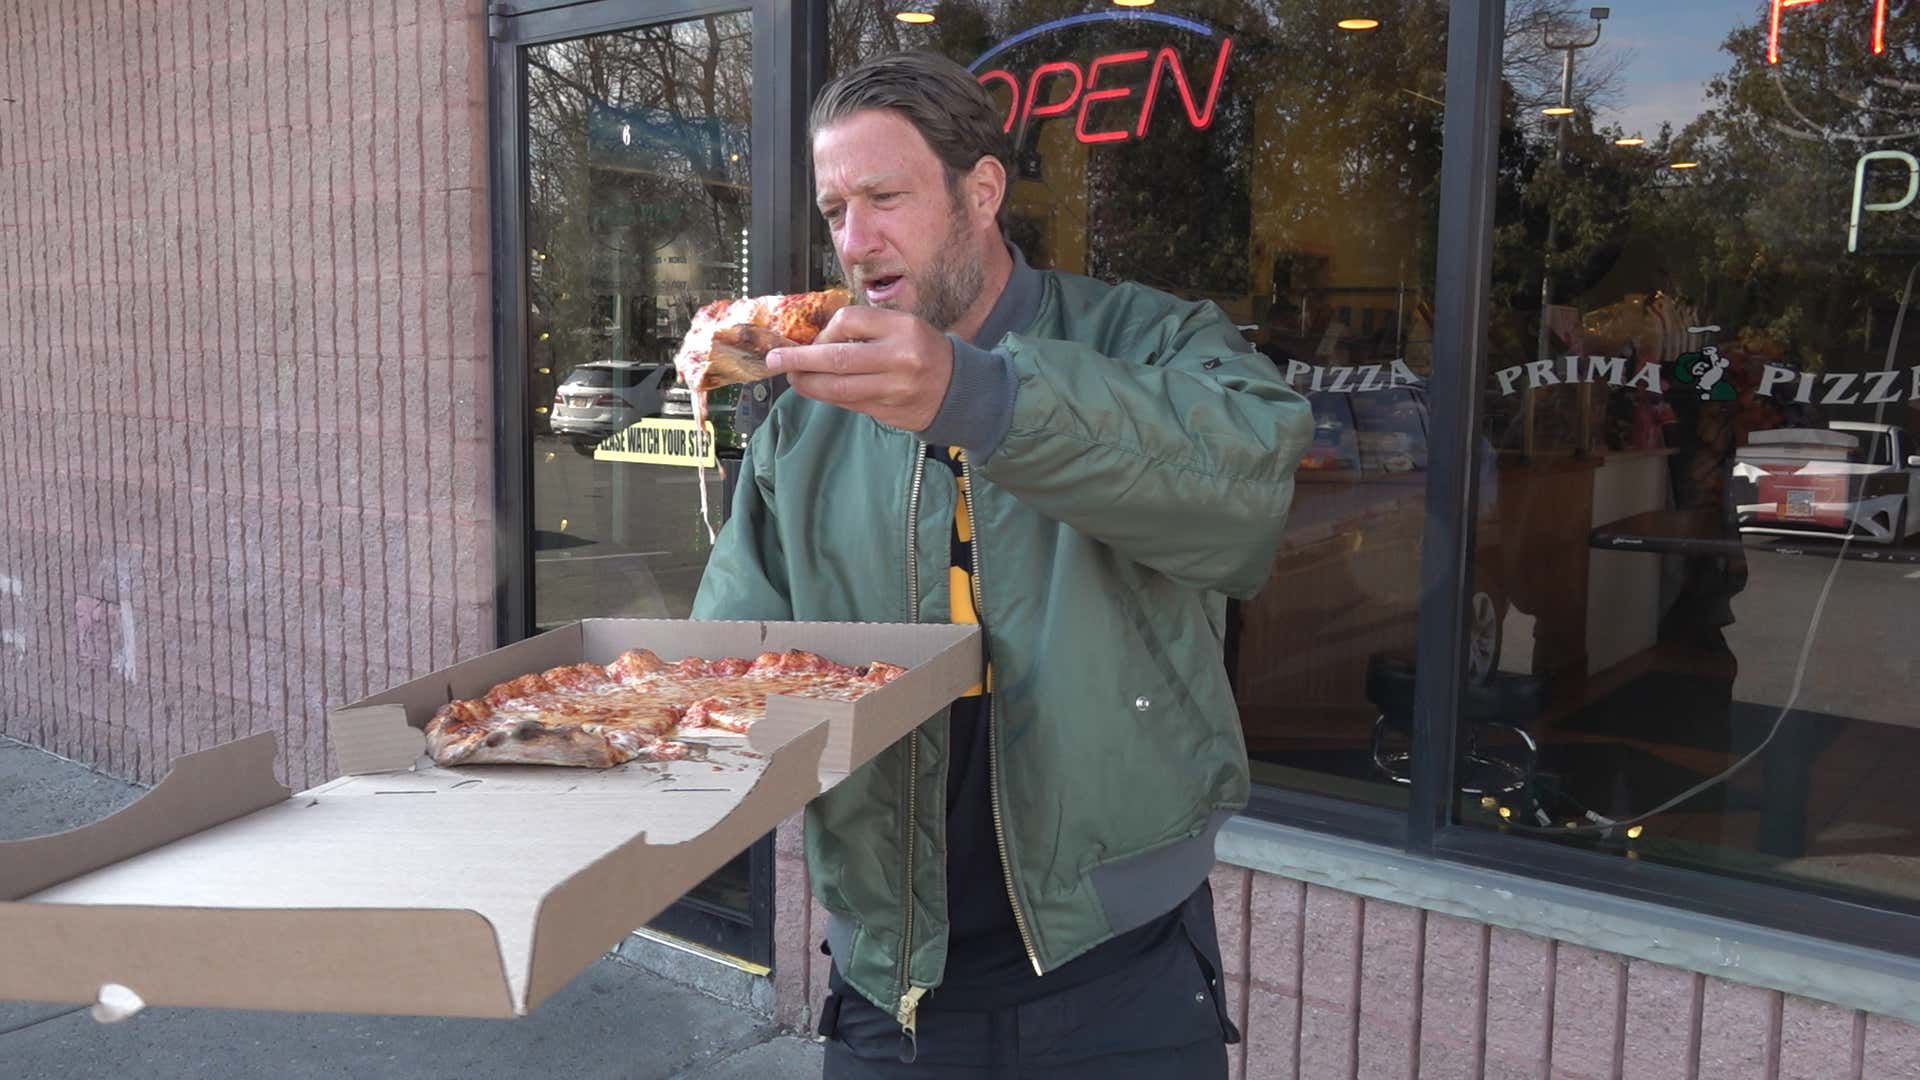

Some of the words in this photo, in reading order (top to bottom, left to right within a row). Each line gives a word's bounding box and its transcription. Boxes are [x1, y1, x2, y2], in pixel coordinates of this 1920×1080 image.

[1285, 357, 1420, 393] PIZZA
[1496, 354, 1664, 397] PRIMA
[600, 431, 626, 452] LEASE
[627, 427, 660, 454] WATCH
[661, 429, 687, 456] YOUR
[688, 430, 712, 458] STEP
